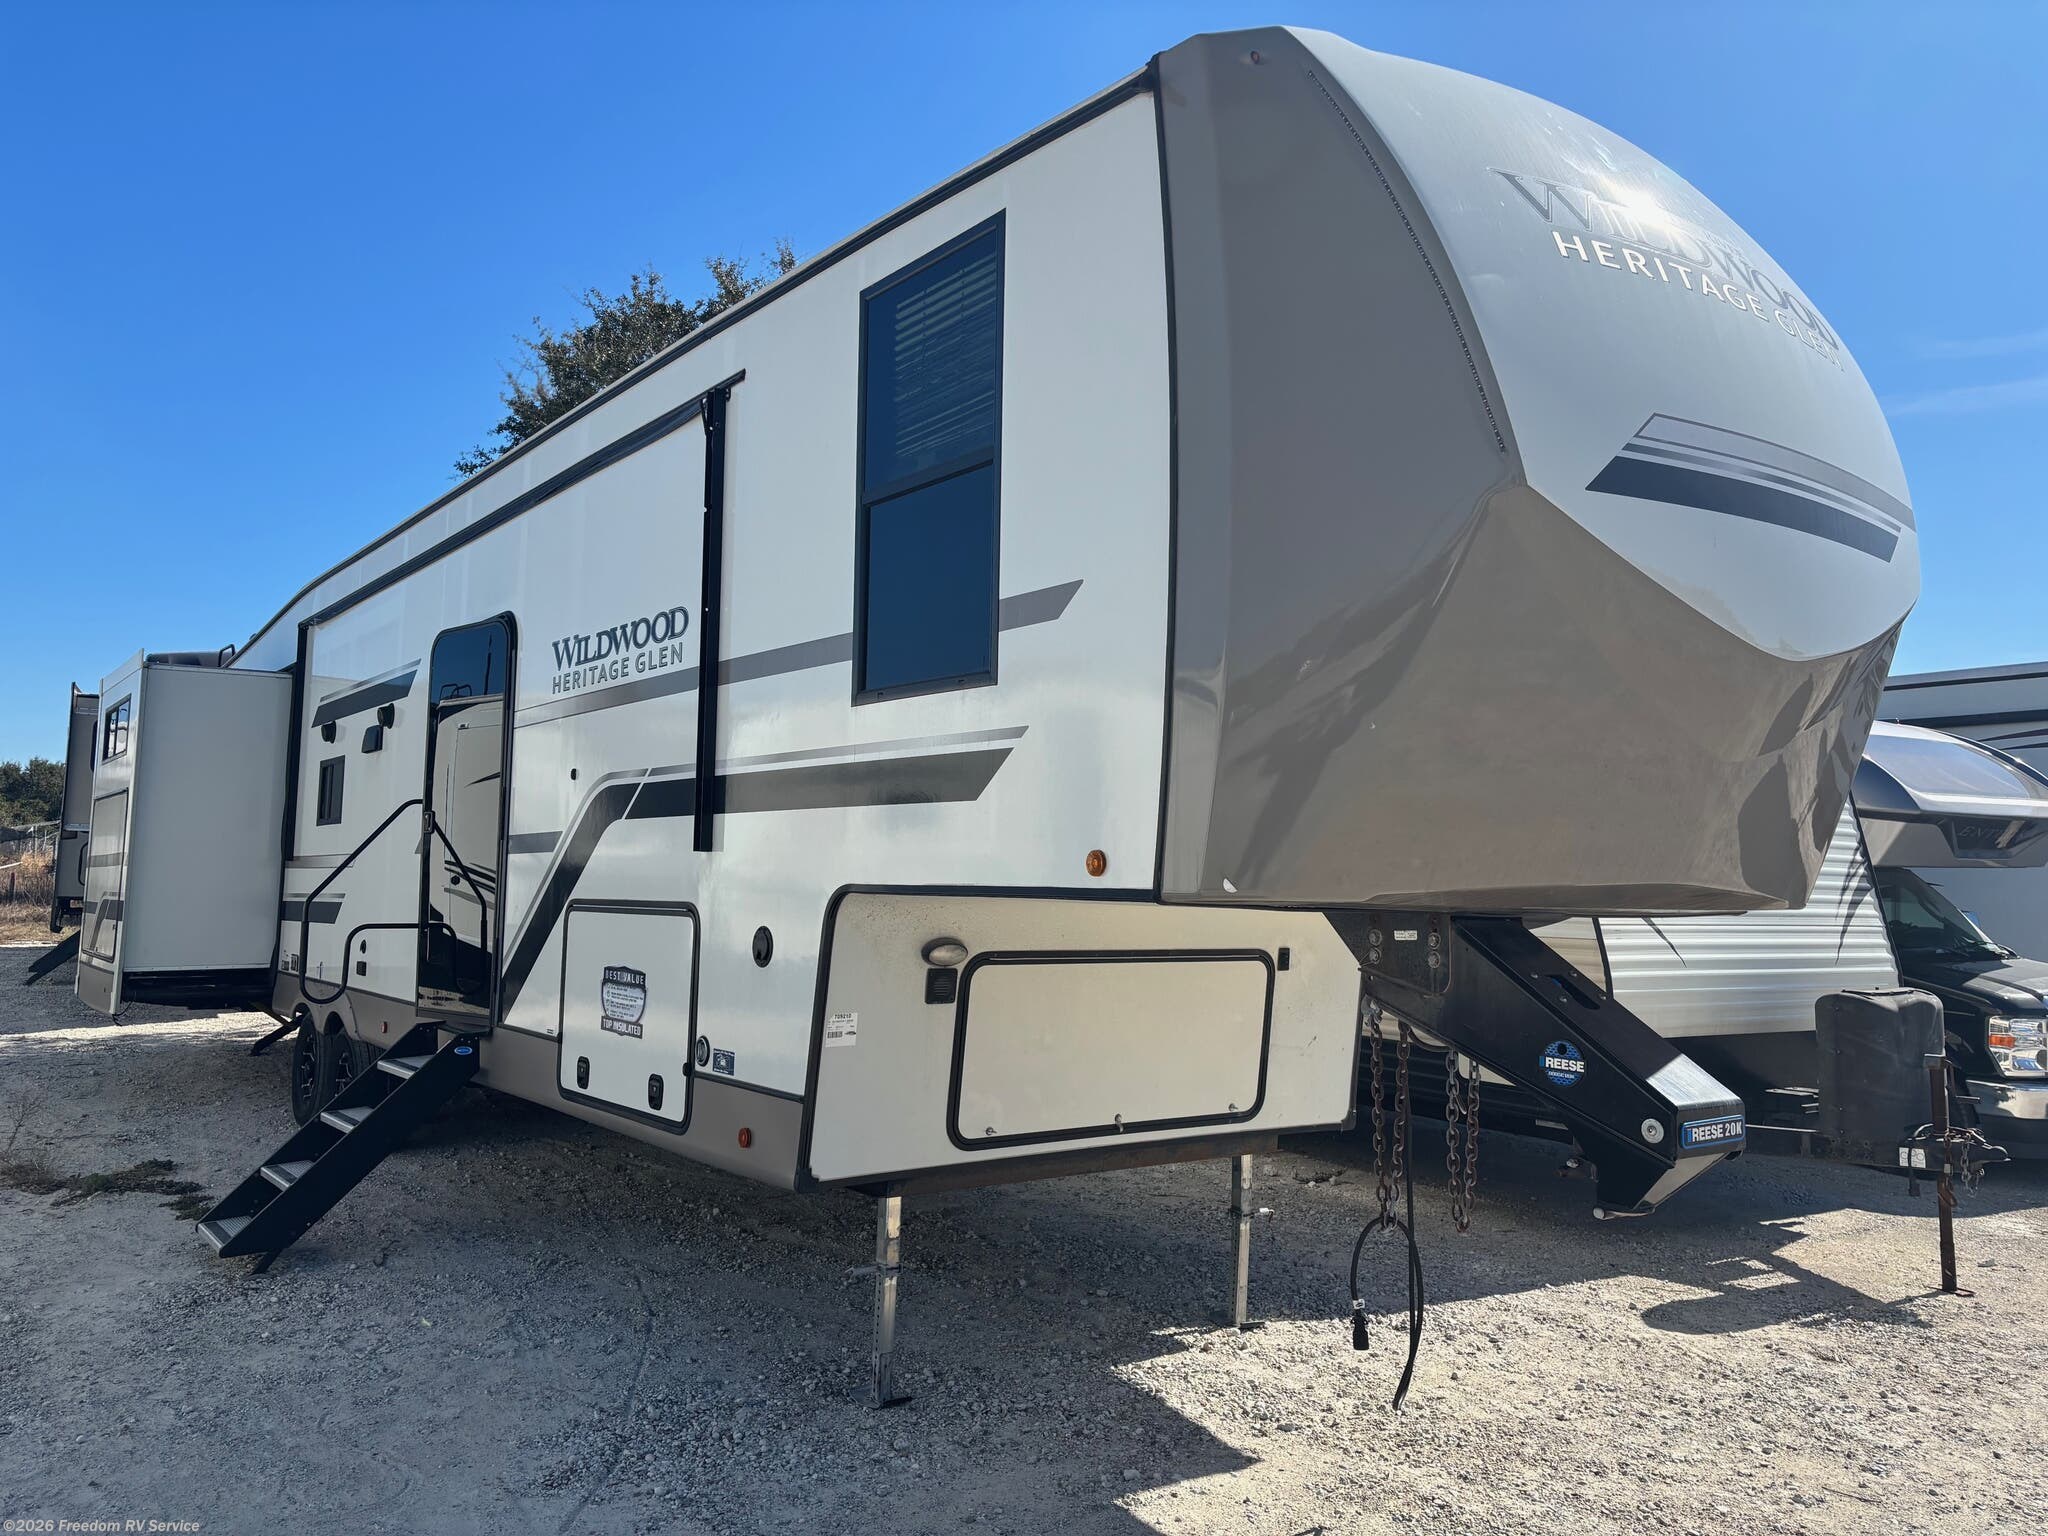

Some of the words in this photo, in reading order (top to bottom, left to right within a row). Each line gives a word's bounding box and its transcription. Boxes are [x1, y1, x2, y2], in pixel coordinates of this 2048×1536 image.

[1552, 231, 1770, 322] HERITAGE
[1774, 309, 1844, 372] GLEN
[552, 606, 689, 672] WILDWOOD
[552, 657, 630, 694] HERITAGE
[635, 642, 683, 674] GLEN
[605, 970, 620, 981] BEST
[623, 972, 644, 985] VALUE
[603, 1019, 613, 1029] TOP
[613, 1022, 641, 1035] INSULATED
[1545, 1056, 1585, 1073] REESE
[1692, 1124, 1724, 1142] REESE
[1725, 1121, 1743, 1137] 20K
